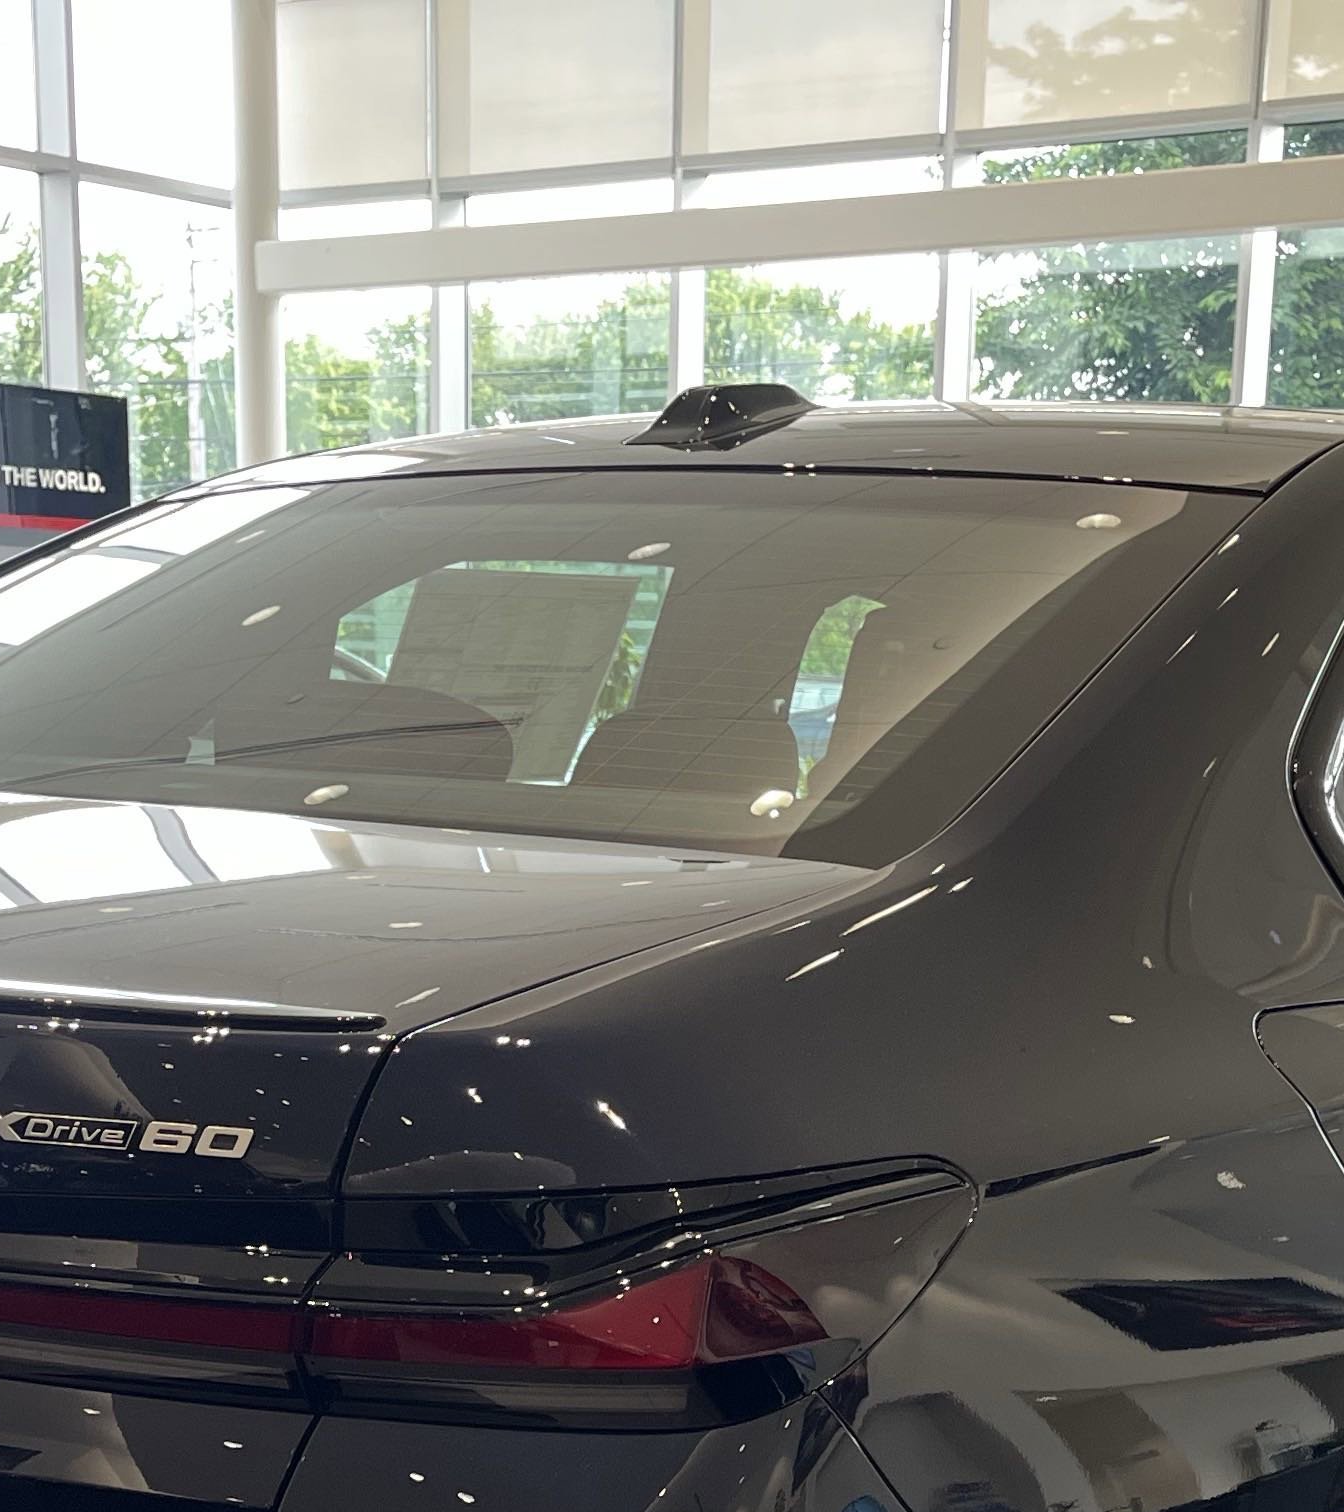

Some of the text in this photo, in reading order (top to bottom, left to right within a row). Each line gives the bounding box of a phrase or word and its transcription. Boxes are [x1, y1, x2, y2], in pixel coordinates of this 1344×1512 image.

[1, 464, 39, 488] THE
[38, 467, 106, 494] WORLD.
[139, 1120, 254, 1159] 60
